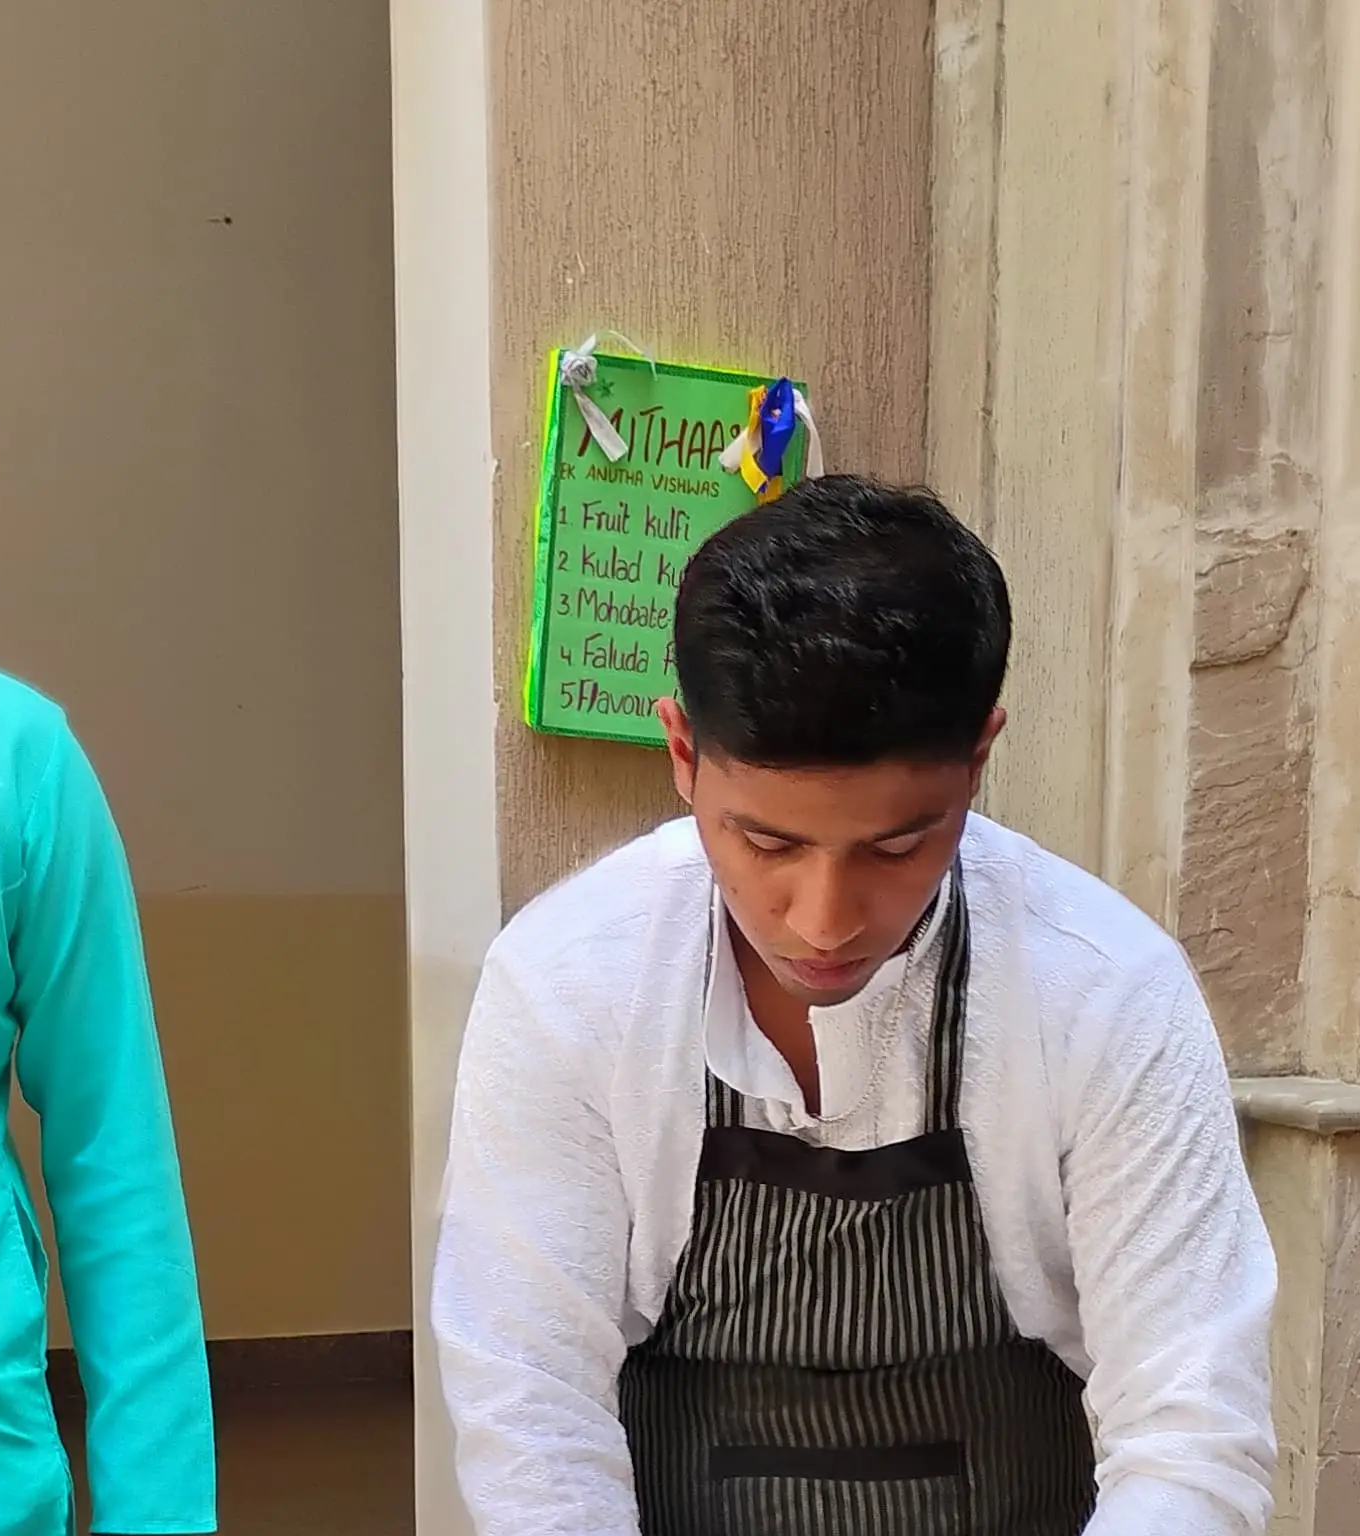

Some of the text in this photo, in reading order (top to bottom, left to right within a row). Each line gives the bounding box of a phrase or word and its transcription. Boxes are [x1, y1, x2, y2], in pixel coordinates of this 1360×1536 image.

[559, 462, 576, 480] EK
[652, 473, 721, 498] VISHWAS
[582, 500, 630, 534] Fruit
[583, 633, 649, 673] Faluda
[577, 679, 678, 718] Flavour
